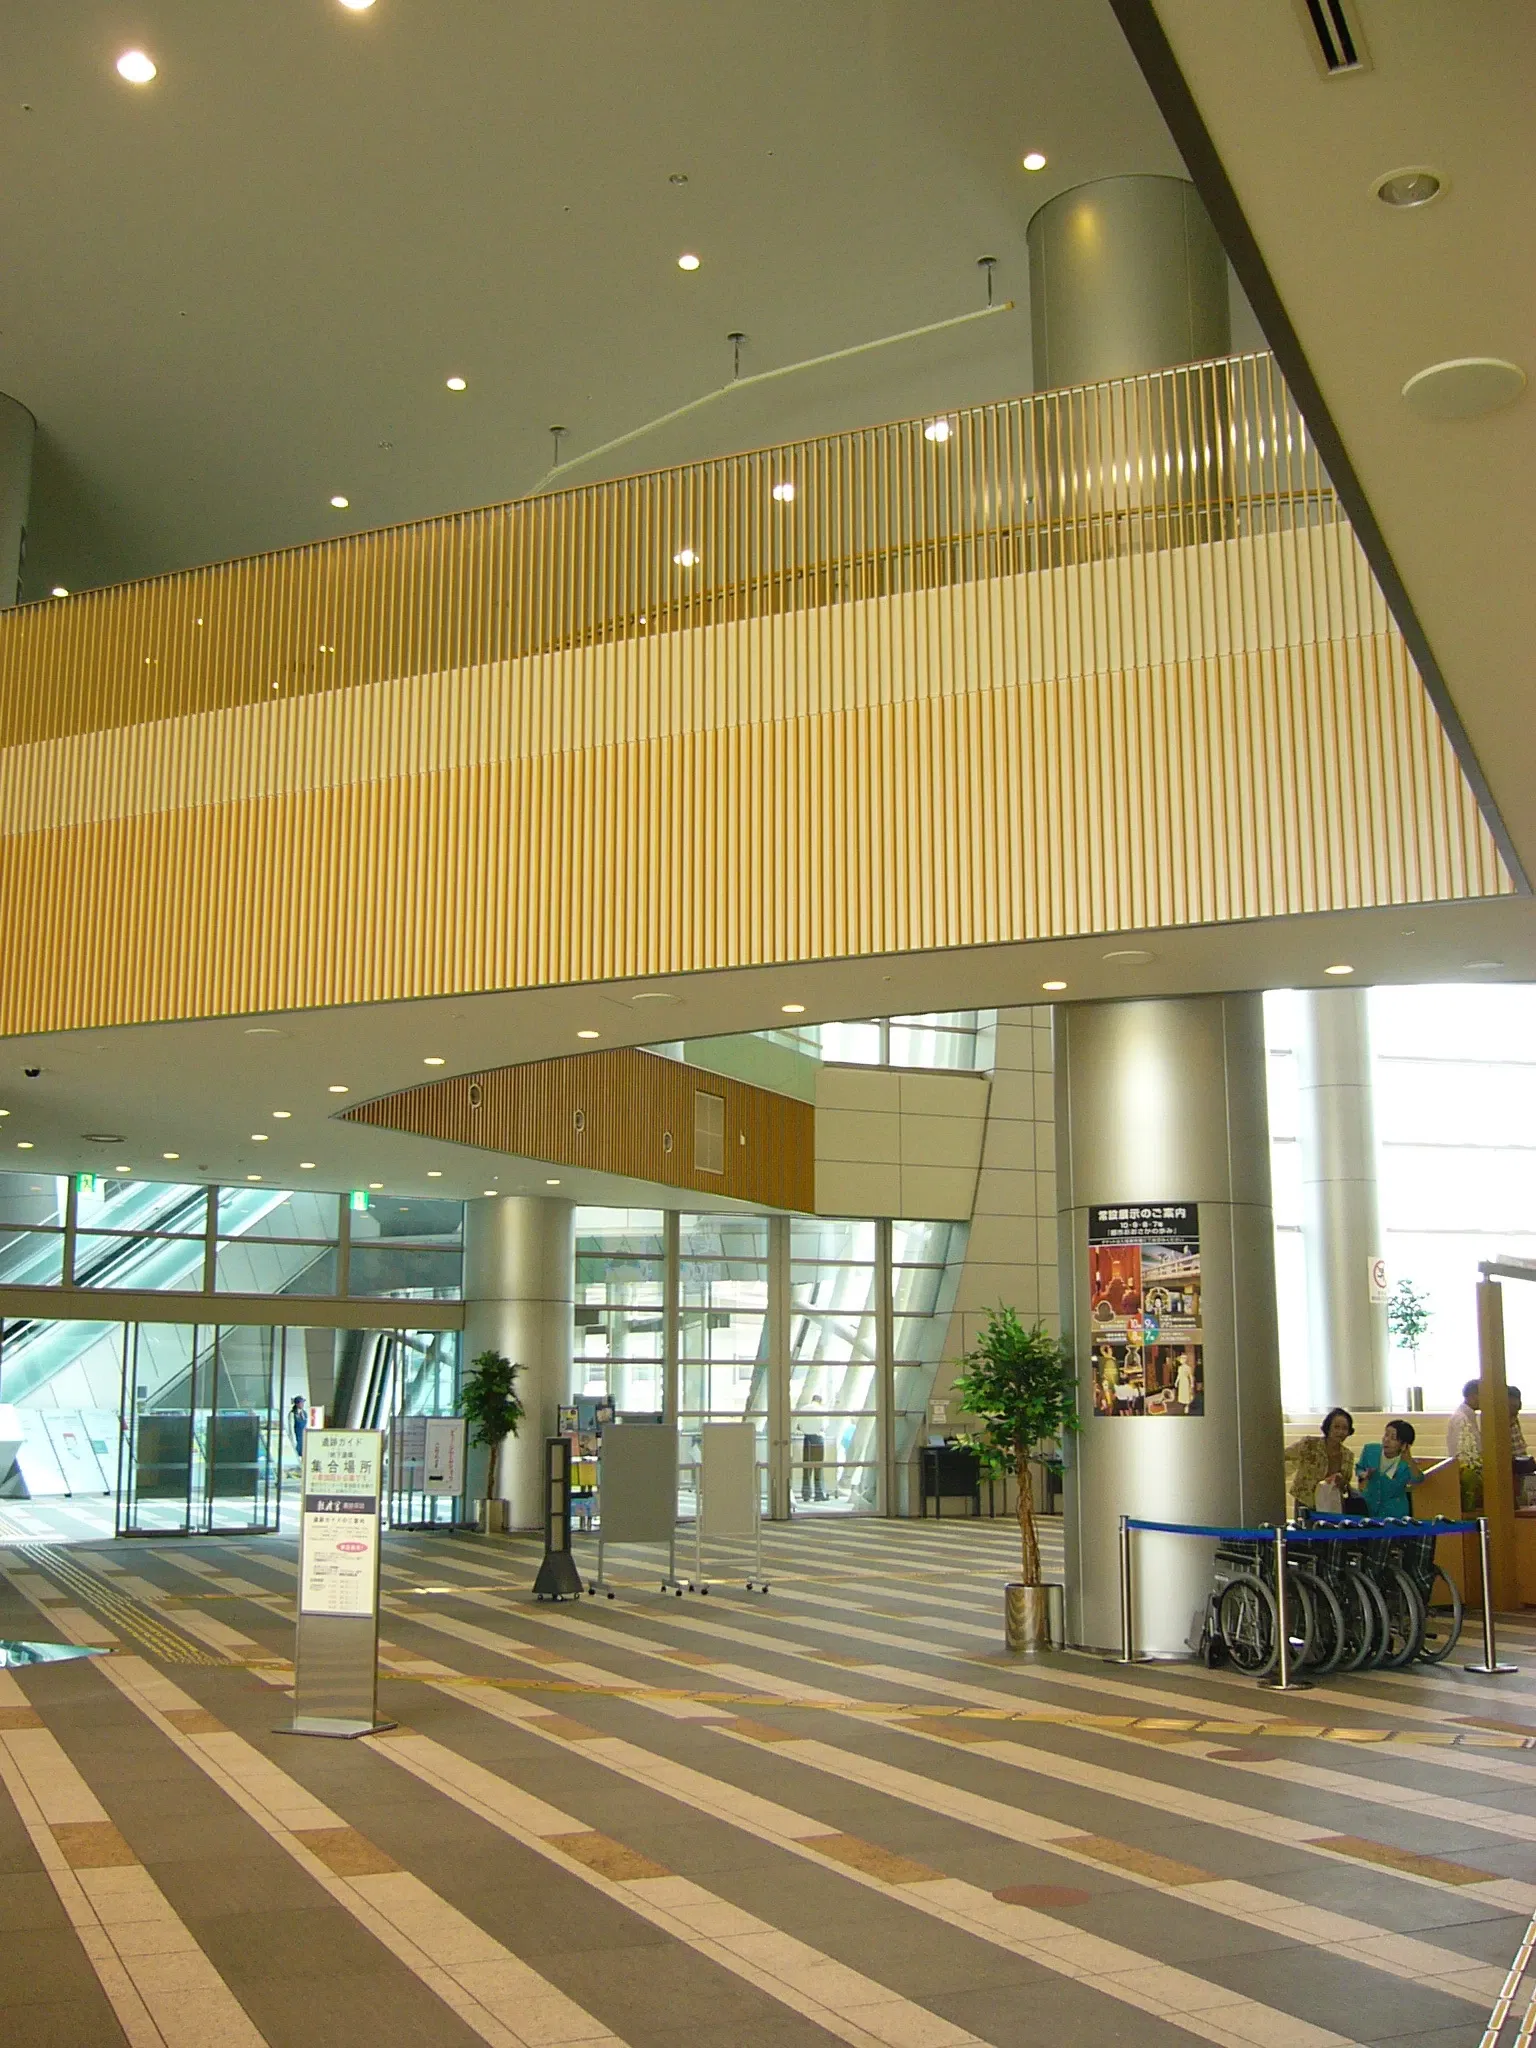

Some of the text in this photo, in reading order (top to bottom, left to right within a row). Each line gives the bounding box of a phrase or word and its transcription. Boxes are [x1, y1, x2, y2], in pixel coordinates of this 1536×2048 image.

[1098, 1208, 1187, 1221] 常設展示のご案内
[310, 1459, 372, 1474] 集合場所
